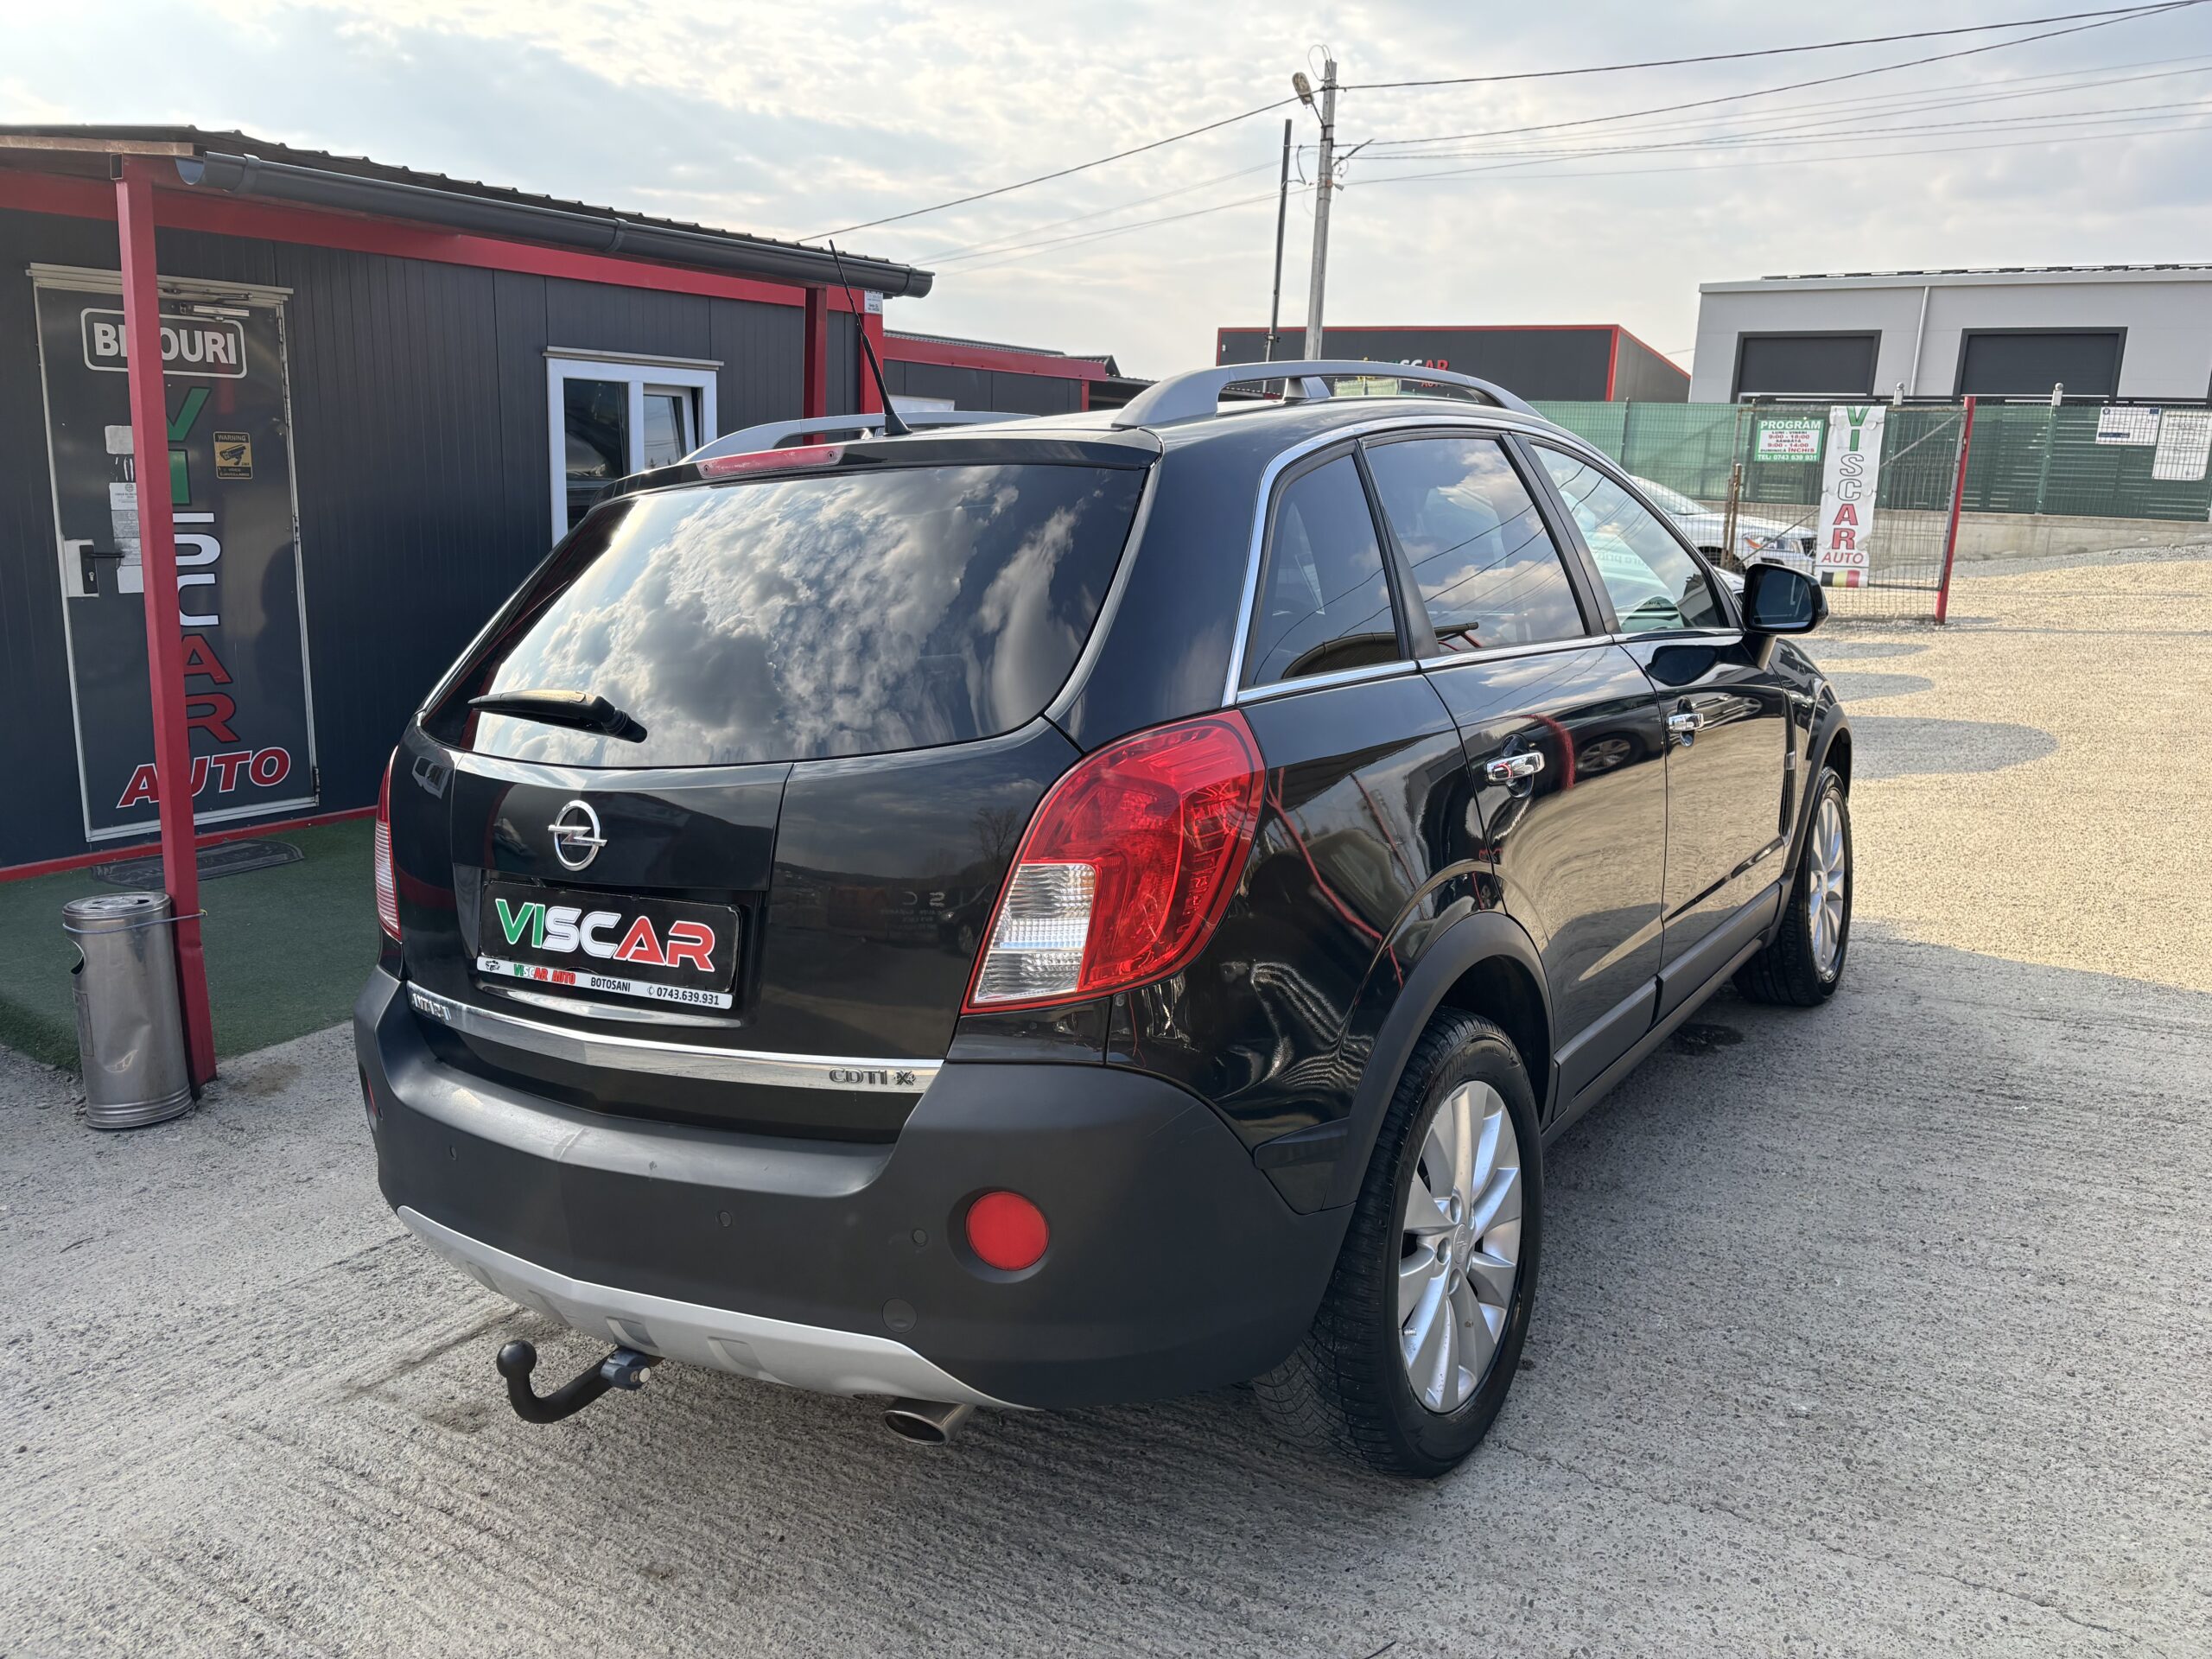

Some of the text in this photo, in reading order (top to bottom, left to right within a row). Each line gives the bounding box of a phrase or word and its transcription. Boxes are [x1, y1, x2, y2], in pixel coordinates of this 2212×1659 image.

[93, 322, 237, 365] BIOURI
[1760, 420, 1821, 429] PROGRAM
[1831, 406, 1870, 550] VISCAR
[1821, 552, 1864, 563] AUTO
[495, 898, 715, 973] VISCAR
[513, 963, 720, 1007] VISCAR AUTO BOTOSANI 0743.639.931
[830, 1068, 887, 1085] CDTI
